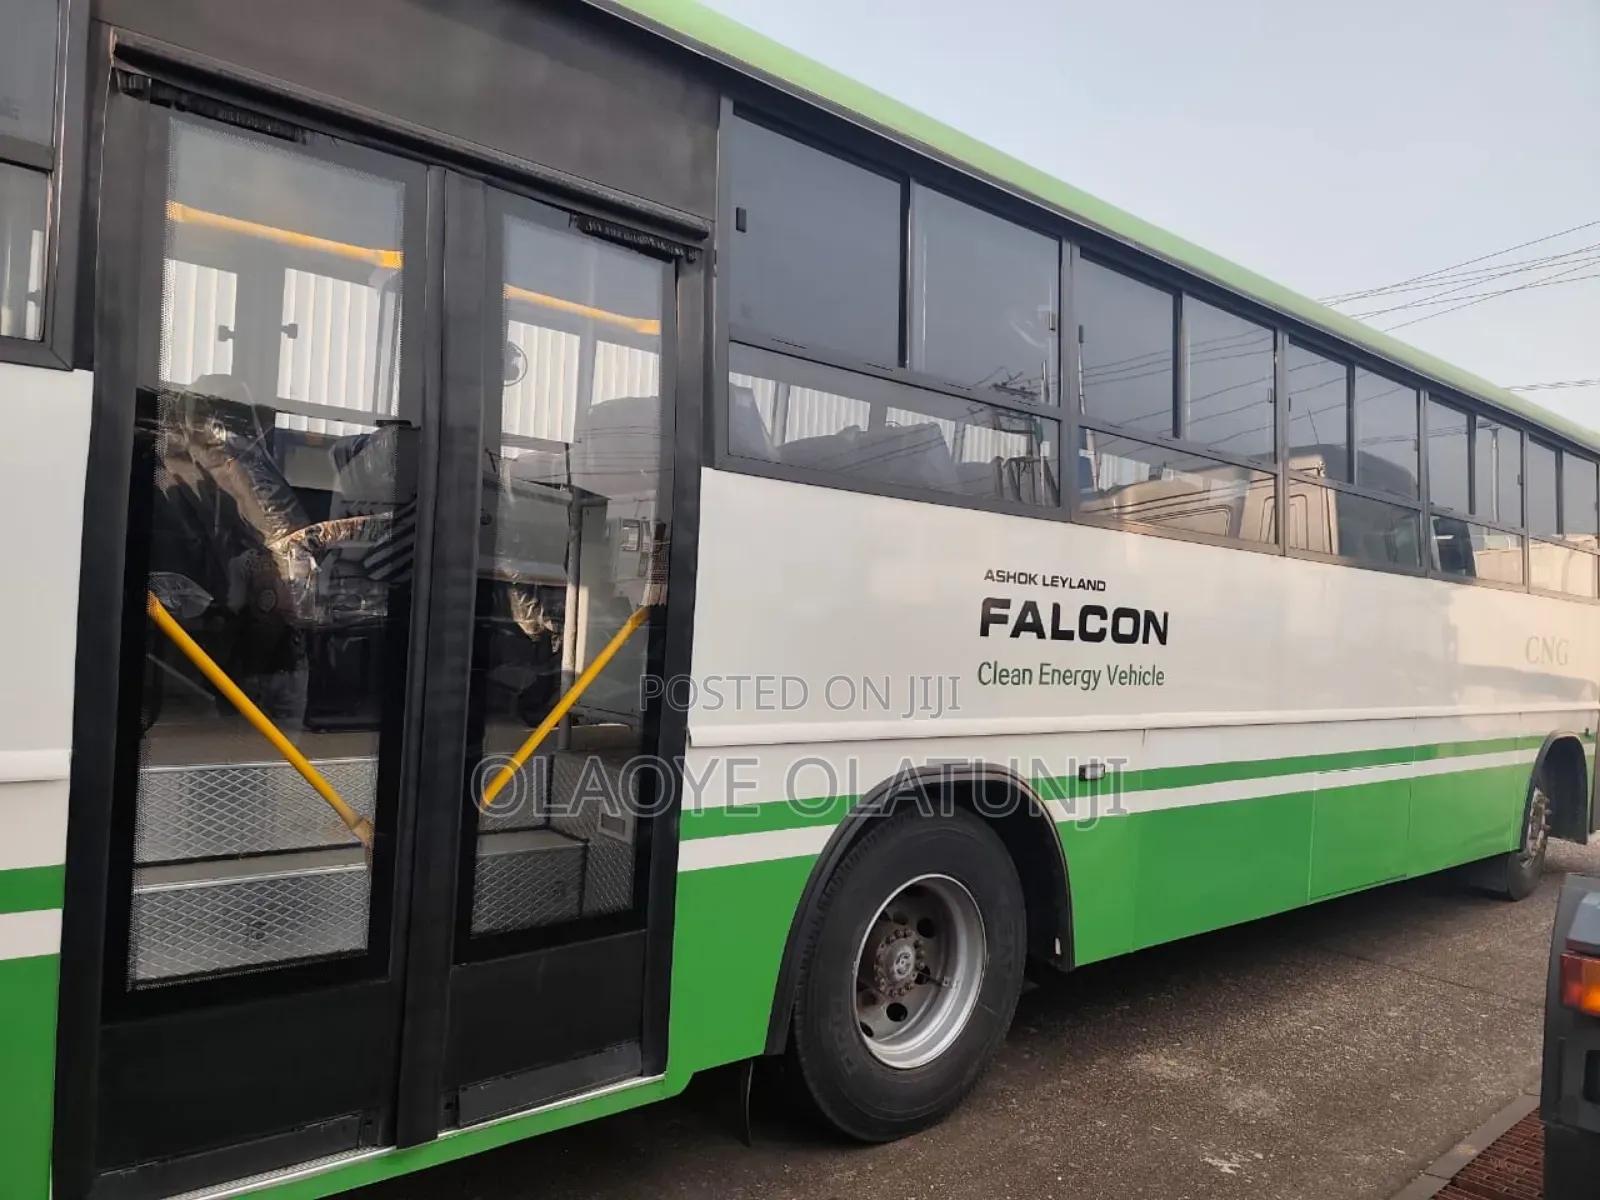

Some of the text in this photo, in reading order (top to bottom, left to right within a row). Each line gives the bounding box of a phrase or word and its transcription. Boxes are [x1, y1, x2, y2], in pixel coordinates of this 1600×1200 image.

[984, 569, 1106, 591] ASHOK LEYLAND
[979, 597, 1169, 646] FALCON
[1525, 635, 1569, 666] CNG
[978, 661, 1165, 690] Clean Energy Vehicle
